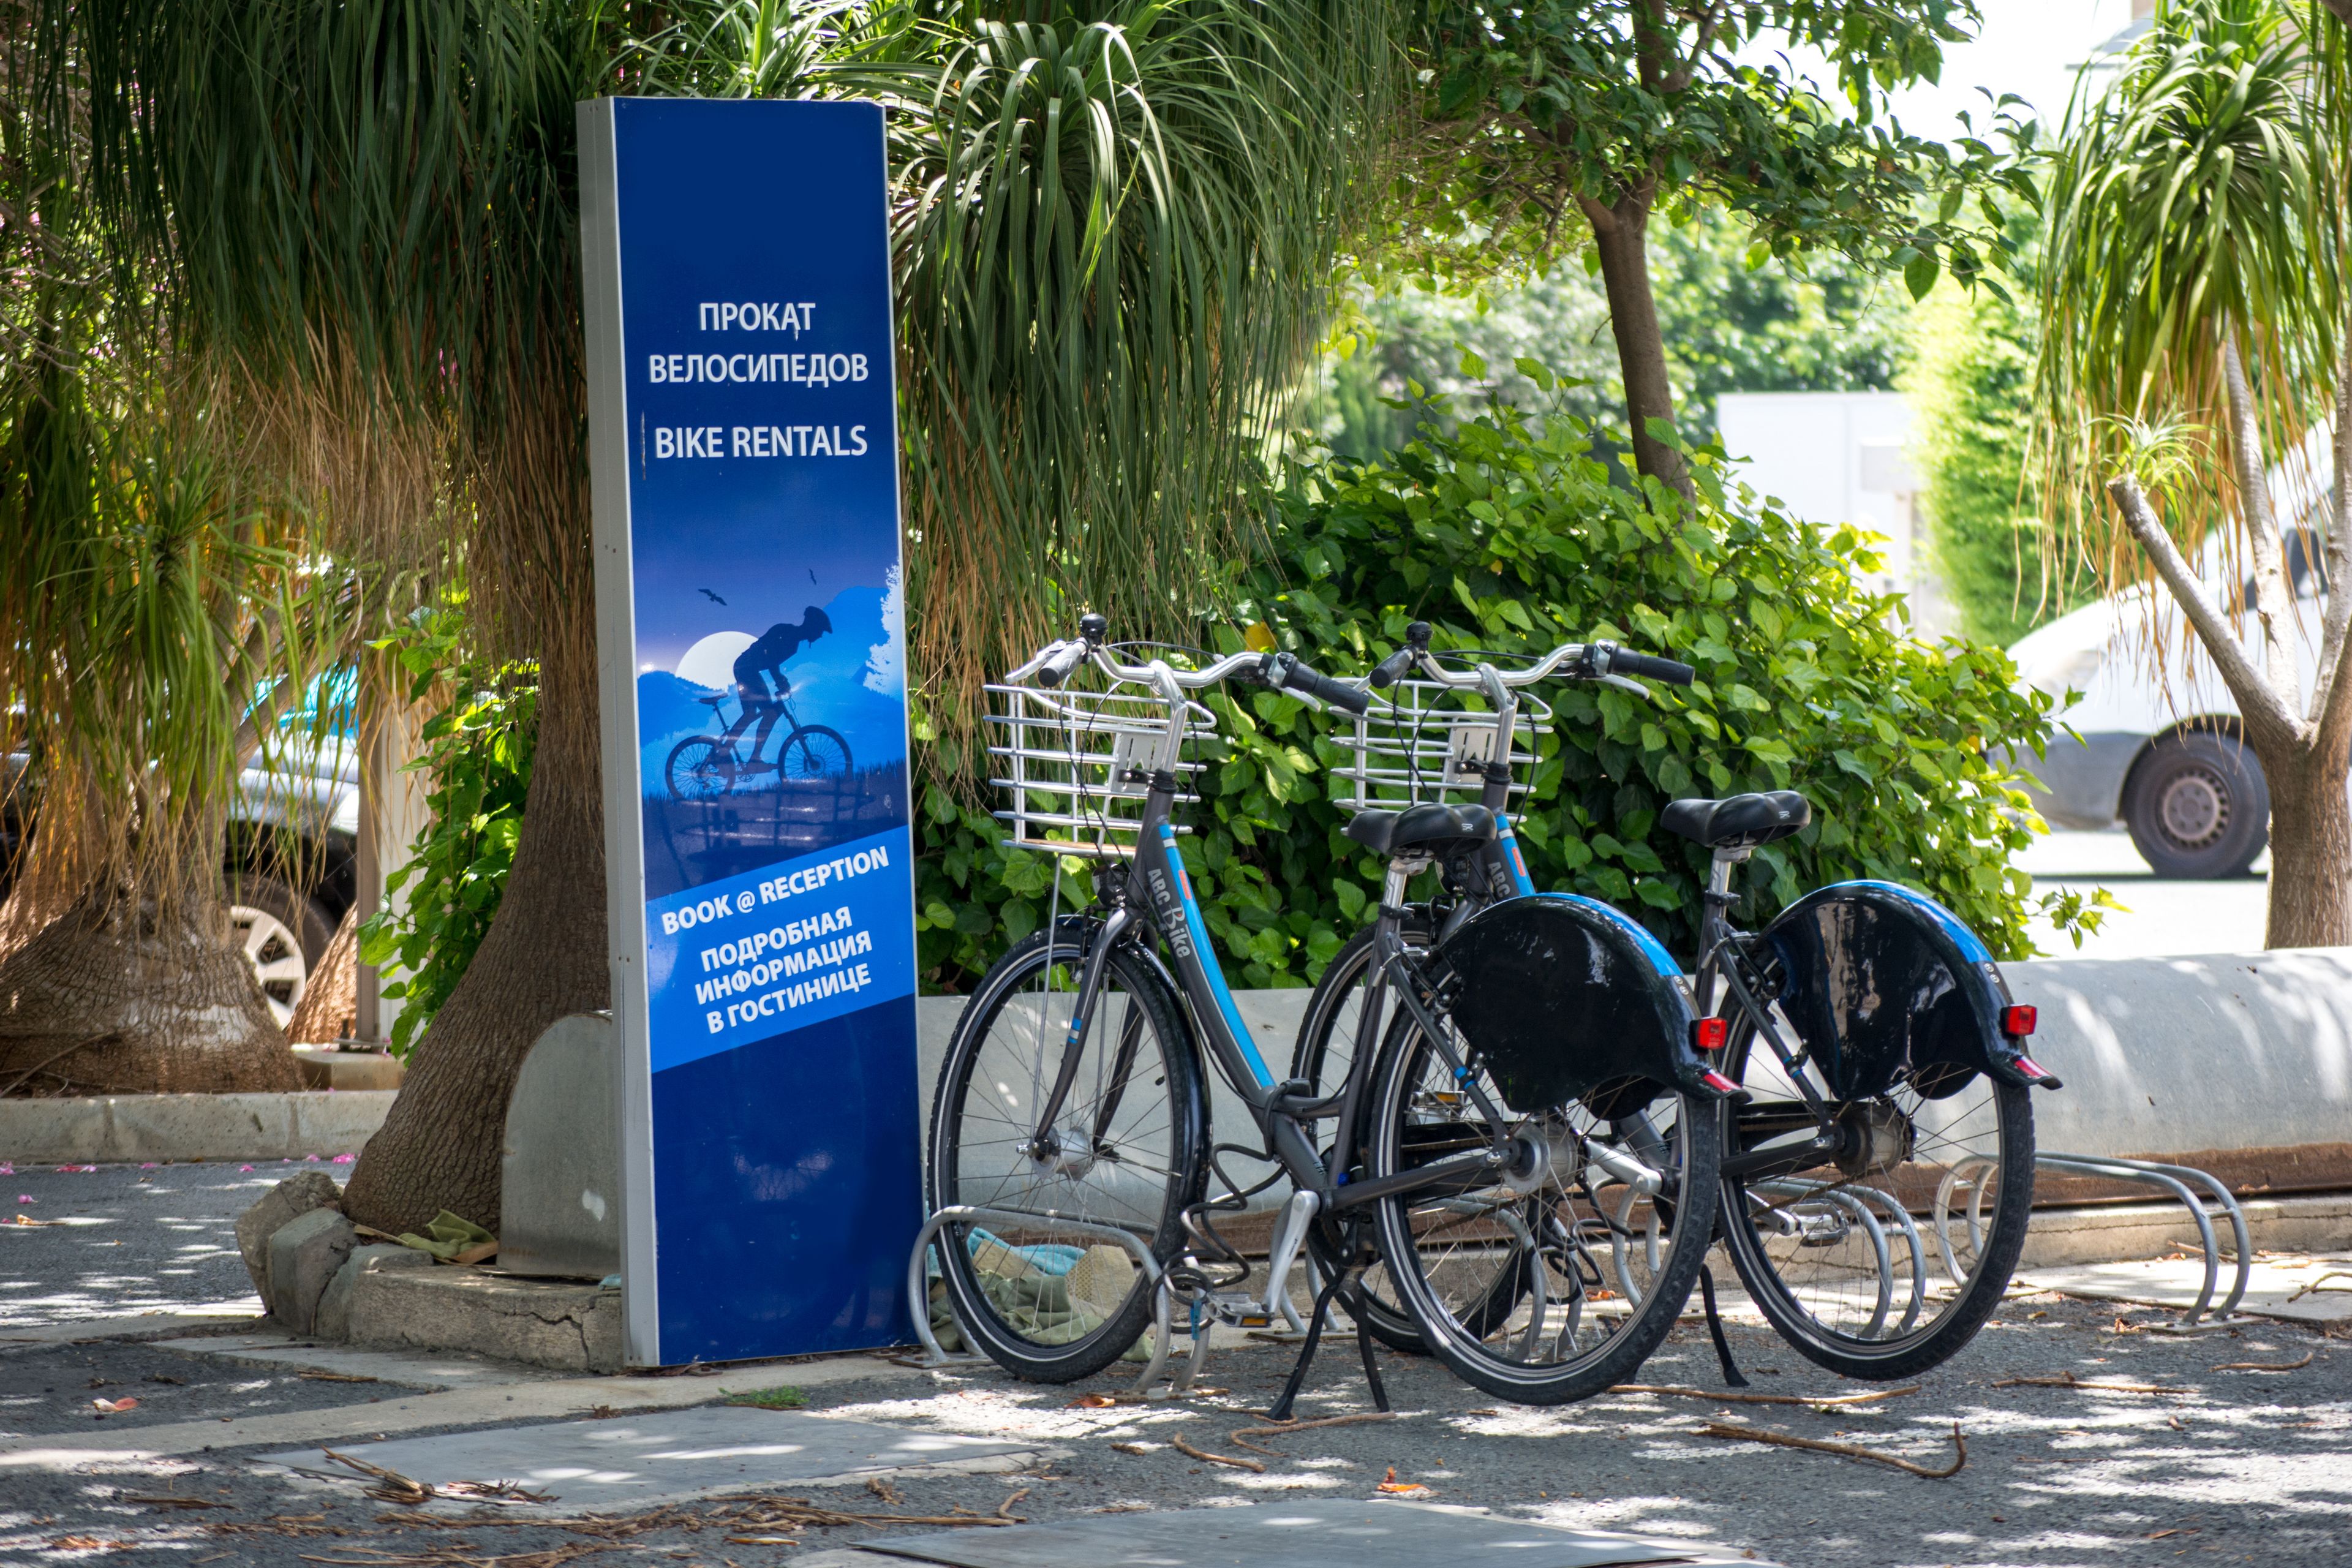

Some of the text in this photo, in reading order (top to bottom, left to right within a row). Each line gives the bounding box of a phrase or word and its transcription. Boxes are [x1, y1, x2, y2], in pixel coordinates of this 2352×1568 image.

[699, 303, 816, 331] ПРОКАТ
[649, 353, 869, 388] ВЕЛОСИПЕДОВ
[655, 425, 867, 459] BIKE RENTALS
[662, 846, 889, 935] BOOK @ RECEPTION
[1147, 868, 1191, 958] ABC Bike
[1488, 862, 1510, 898] ABC
[695, 930, 873, 1005] ИНФОРМАЦИЯ
[700, 906, 853, 972] ПОДРОБНАЯ
[706, 963, 872, 1034] В ГОСТИНИЦЕ
